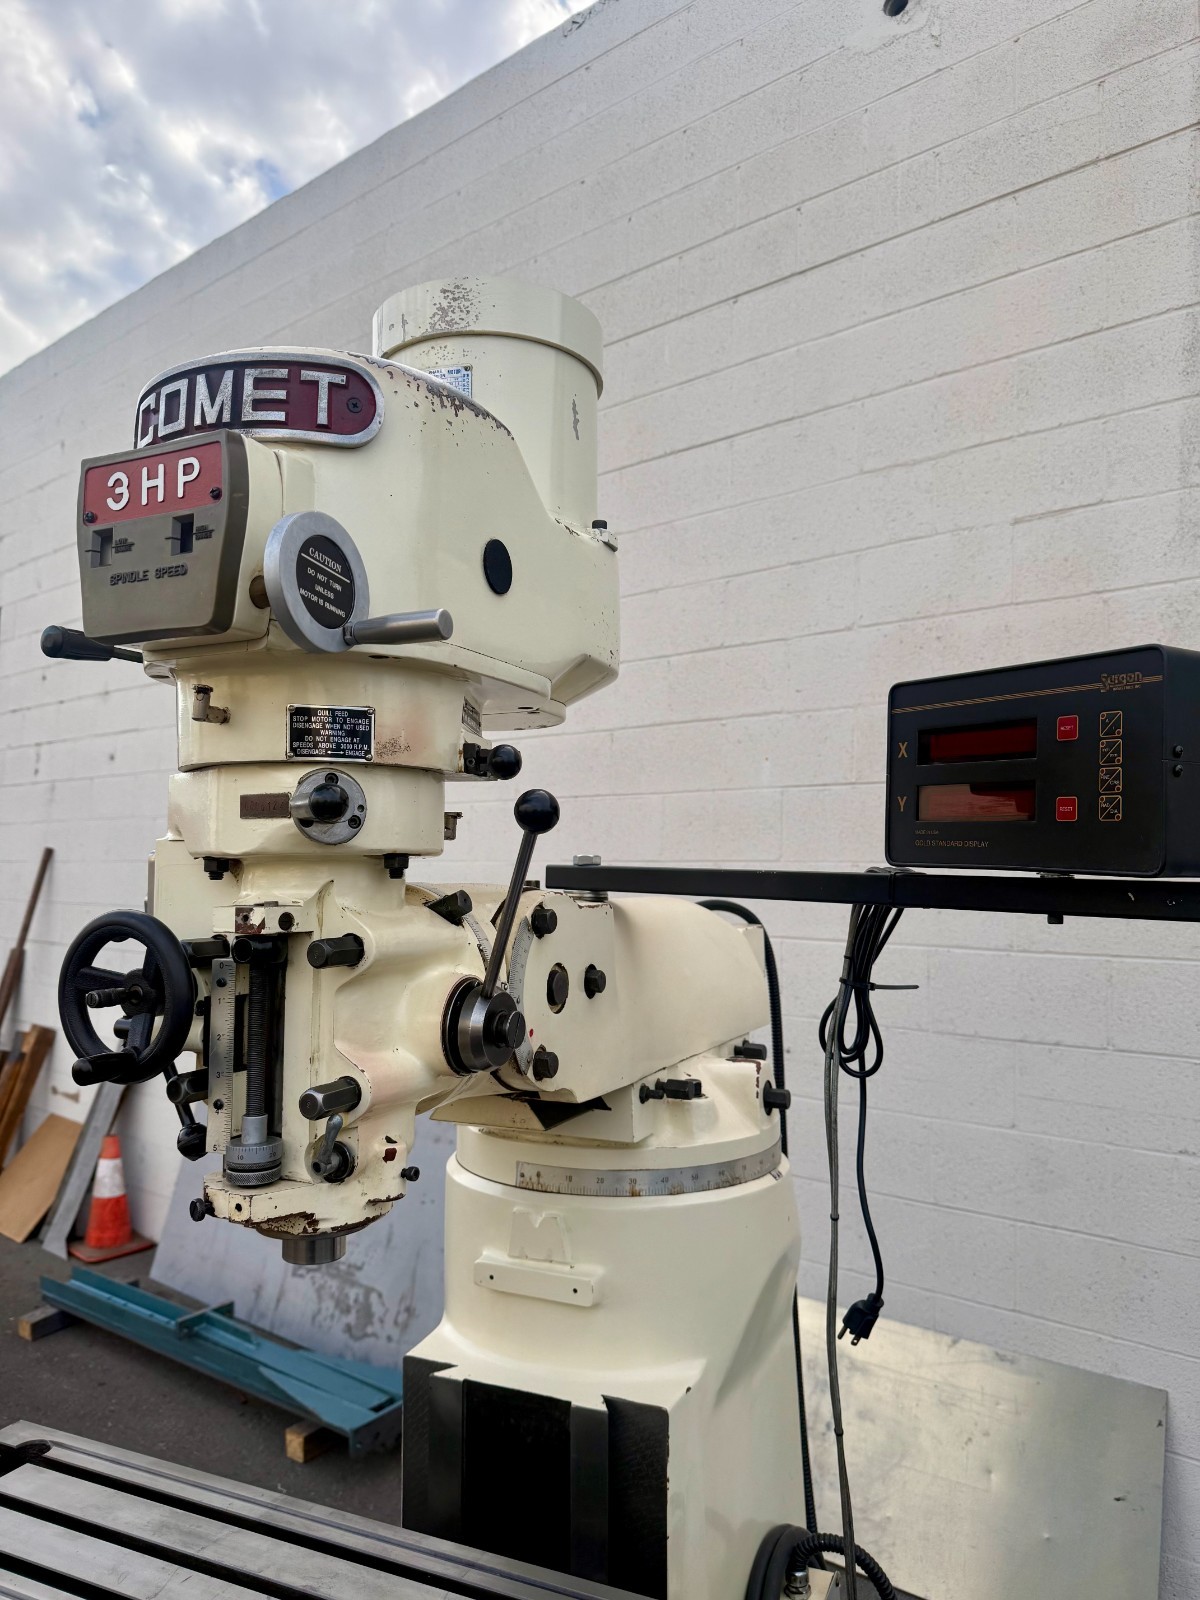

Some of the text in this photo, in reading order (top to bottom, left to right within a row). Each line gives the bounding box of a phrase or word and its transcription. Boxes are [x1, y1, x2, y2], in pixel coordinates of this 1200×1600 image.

[137, 368, 347, 447] COMET
[309, 547, 342, 572] CAUTION
[110, 562, 188, 586] SPINDLE SPEED
[307, 567, 342, 592] DO NOT TURN
[300, 587, 318, 602] MOTOR
[314, 584, 335, 600] UNLESS
[1101, 671, 1142, 693] Sargon
[897, 741, 908, 758] X
[897, 796, 908, 812] Y
[931, 840, 963, 848] STANDARD
[964, 840, 989, 848] DISPLAY
